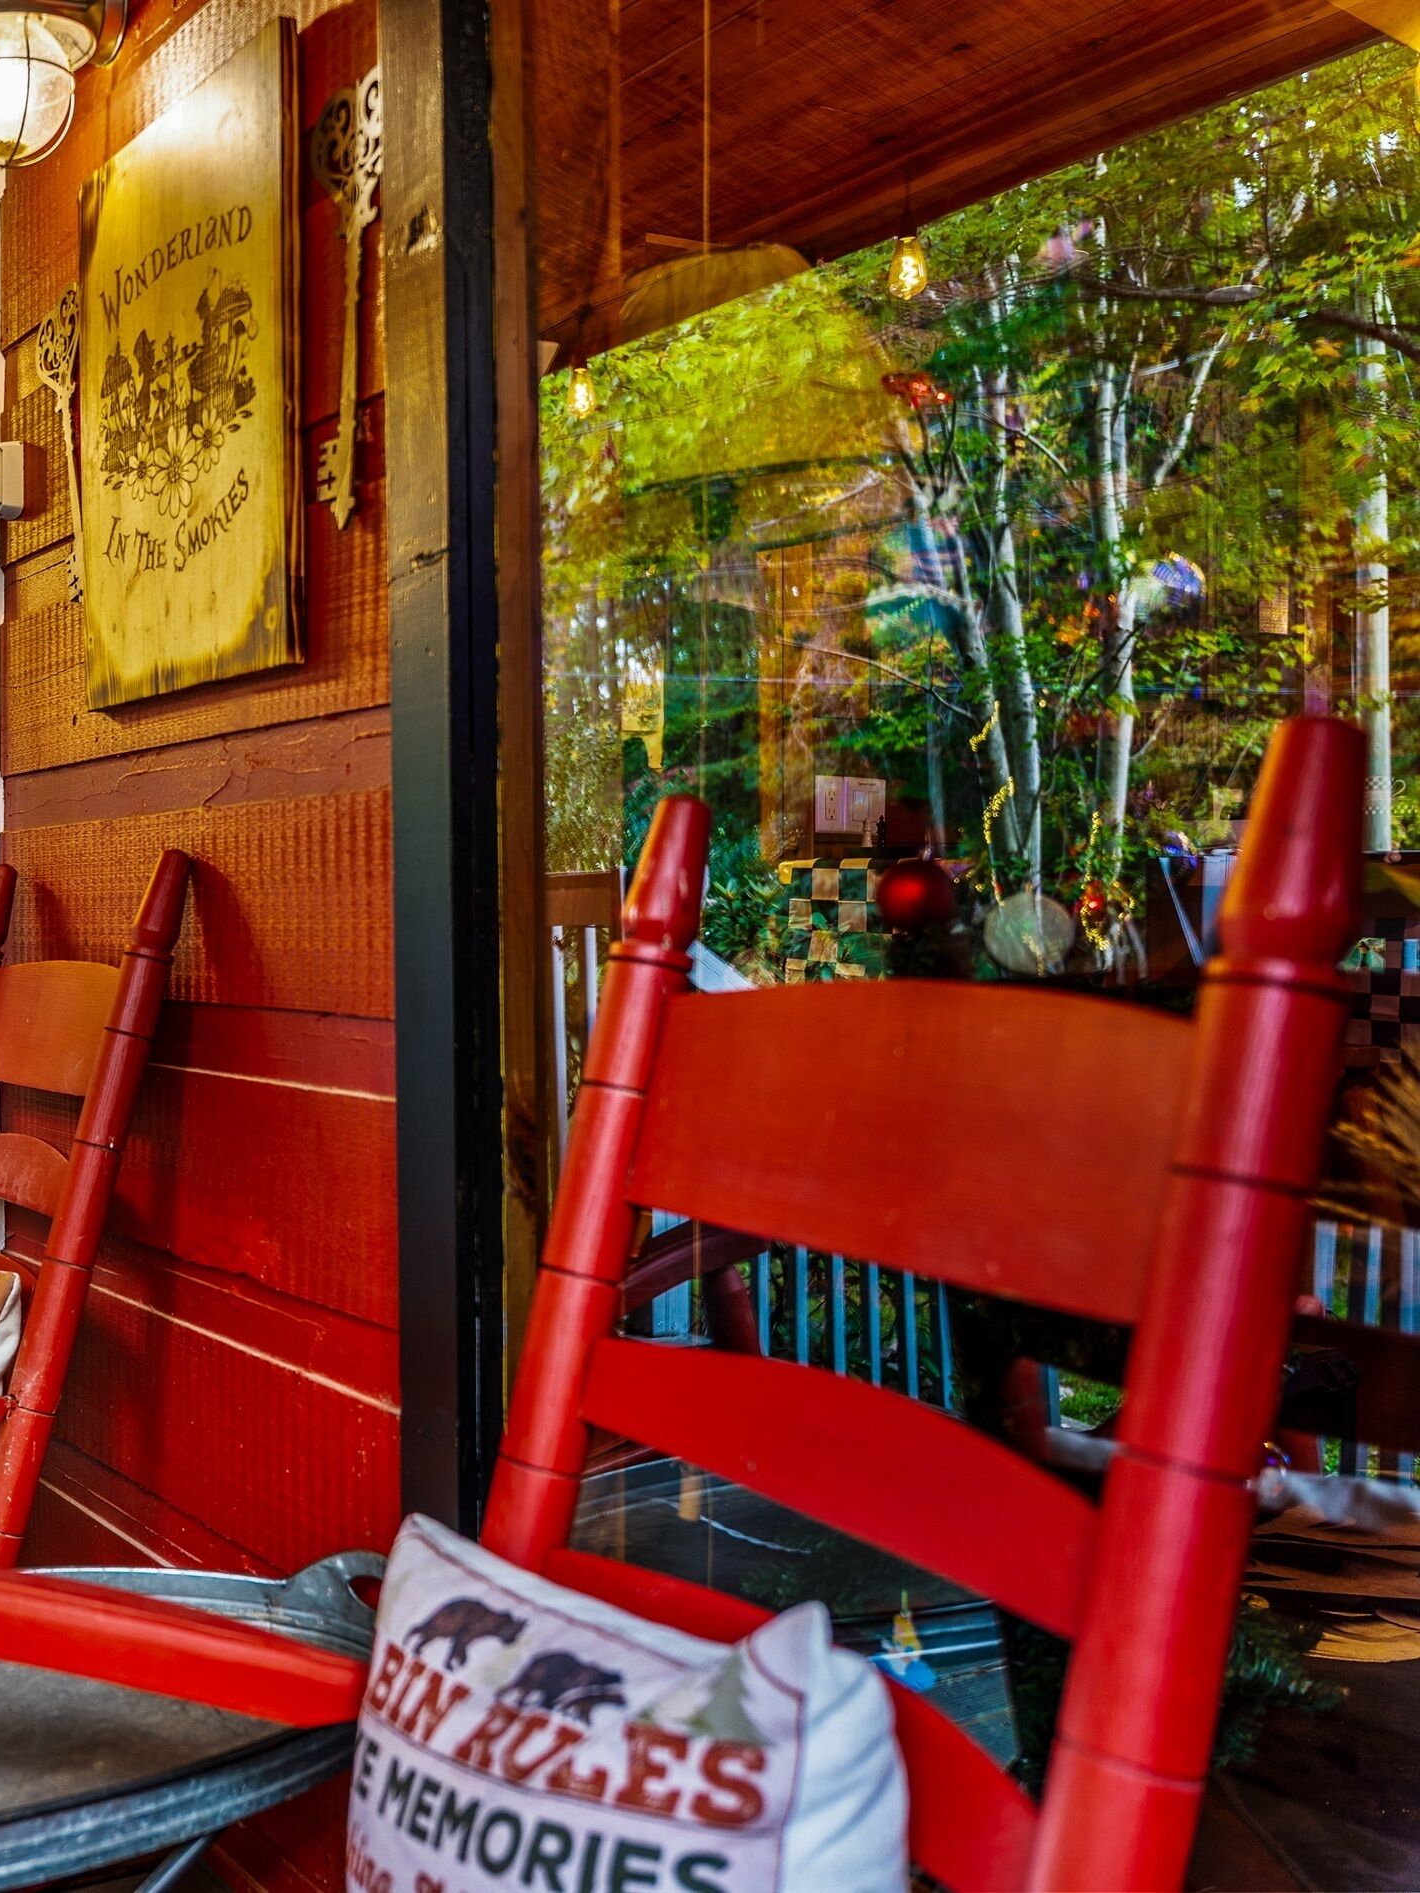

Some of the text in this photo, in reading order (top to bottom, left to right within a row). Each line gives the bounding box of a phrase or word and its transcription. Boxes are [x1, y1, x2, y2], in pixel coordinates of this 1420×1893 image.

[103, 467, 249, 579] IN THE SMOKIES
[369, 1643, 767, 1830] BIN RULES
[377, 1754, 731, 1893] MEMORIES
